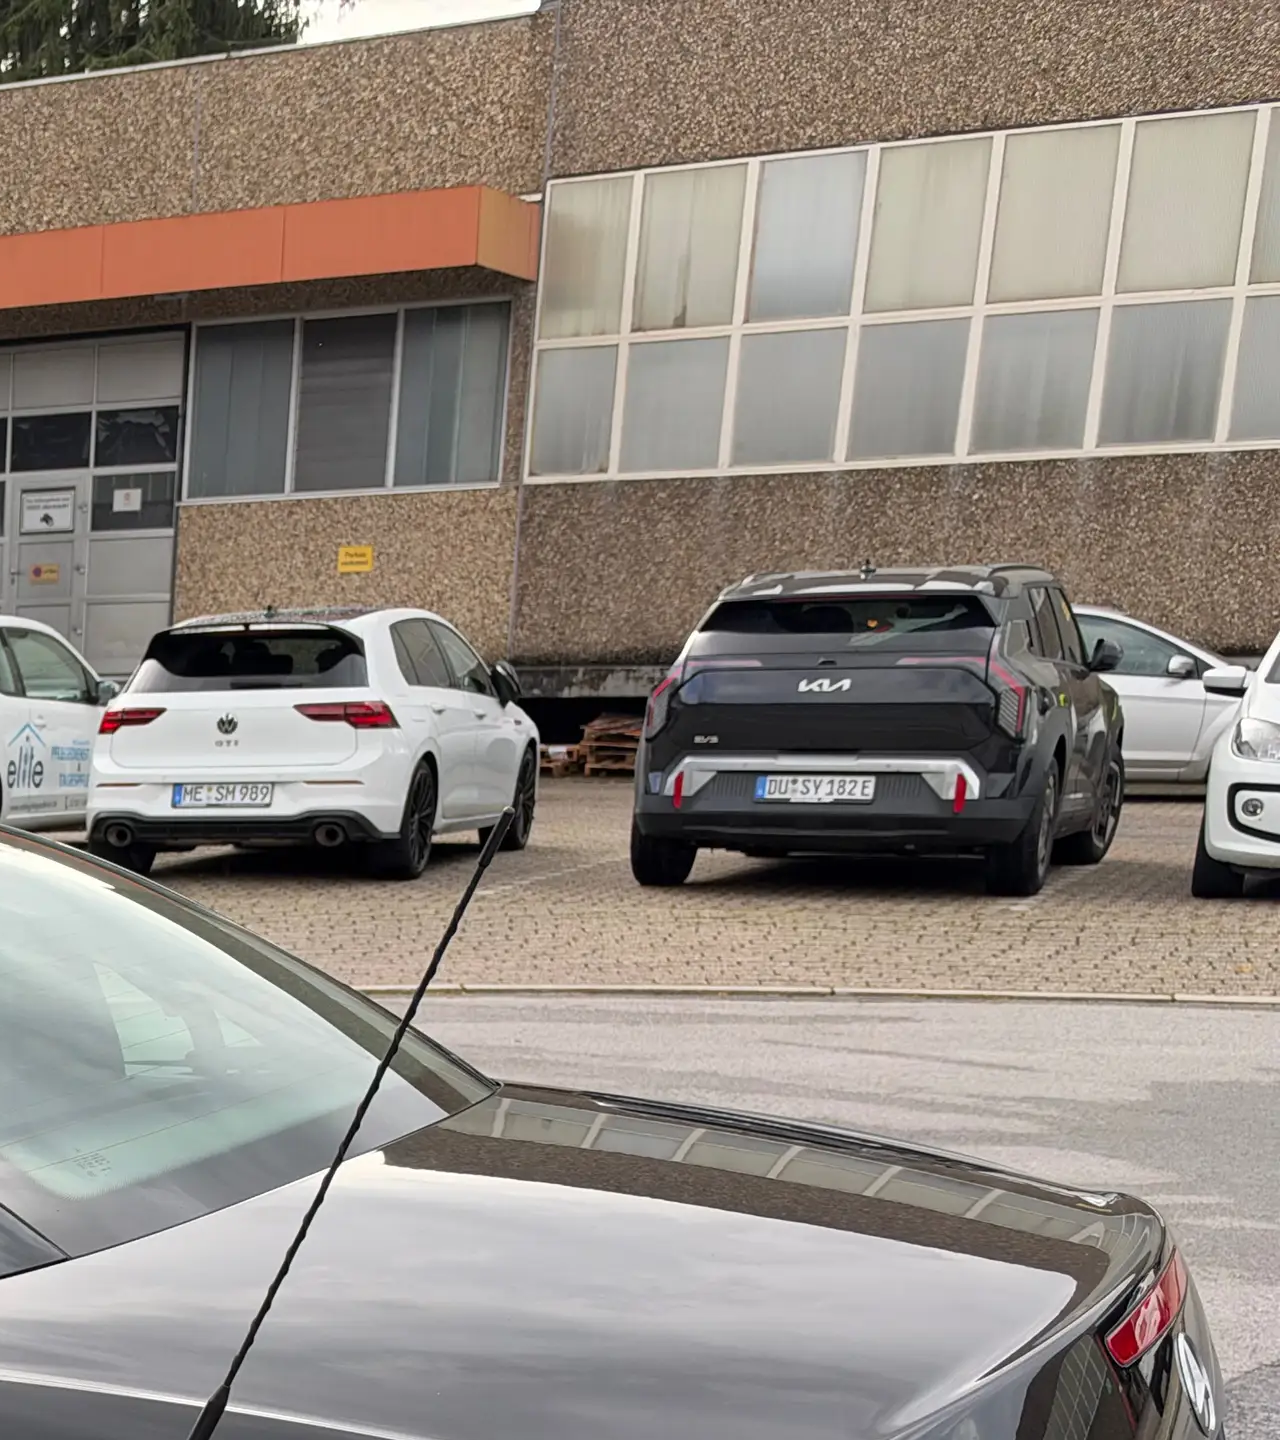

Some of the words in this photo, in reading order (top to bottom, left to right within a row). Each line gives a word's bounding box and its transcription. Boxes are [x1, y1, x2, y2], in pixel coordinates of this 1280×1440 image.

[7, 735, 44, 788] elite
[183, 785, 203, 801] ME
[214, 784, 237, 802] SM
[239, 784, 270, 802] 989
[767, 779, 790, 795] DU
[799, 778, 824, 795] SY
